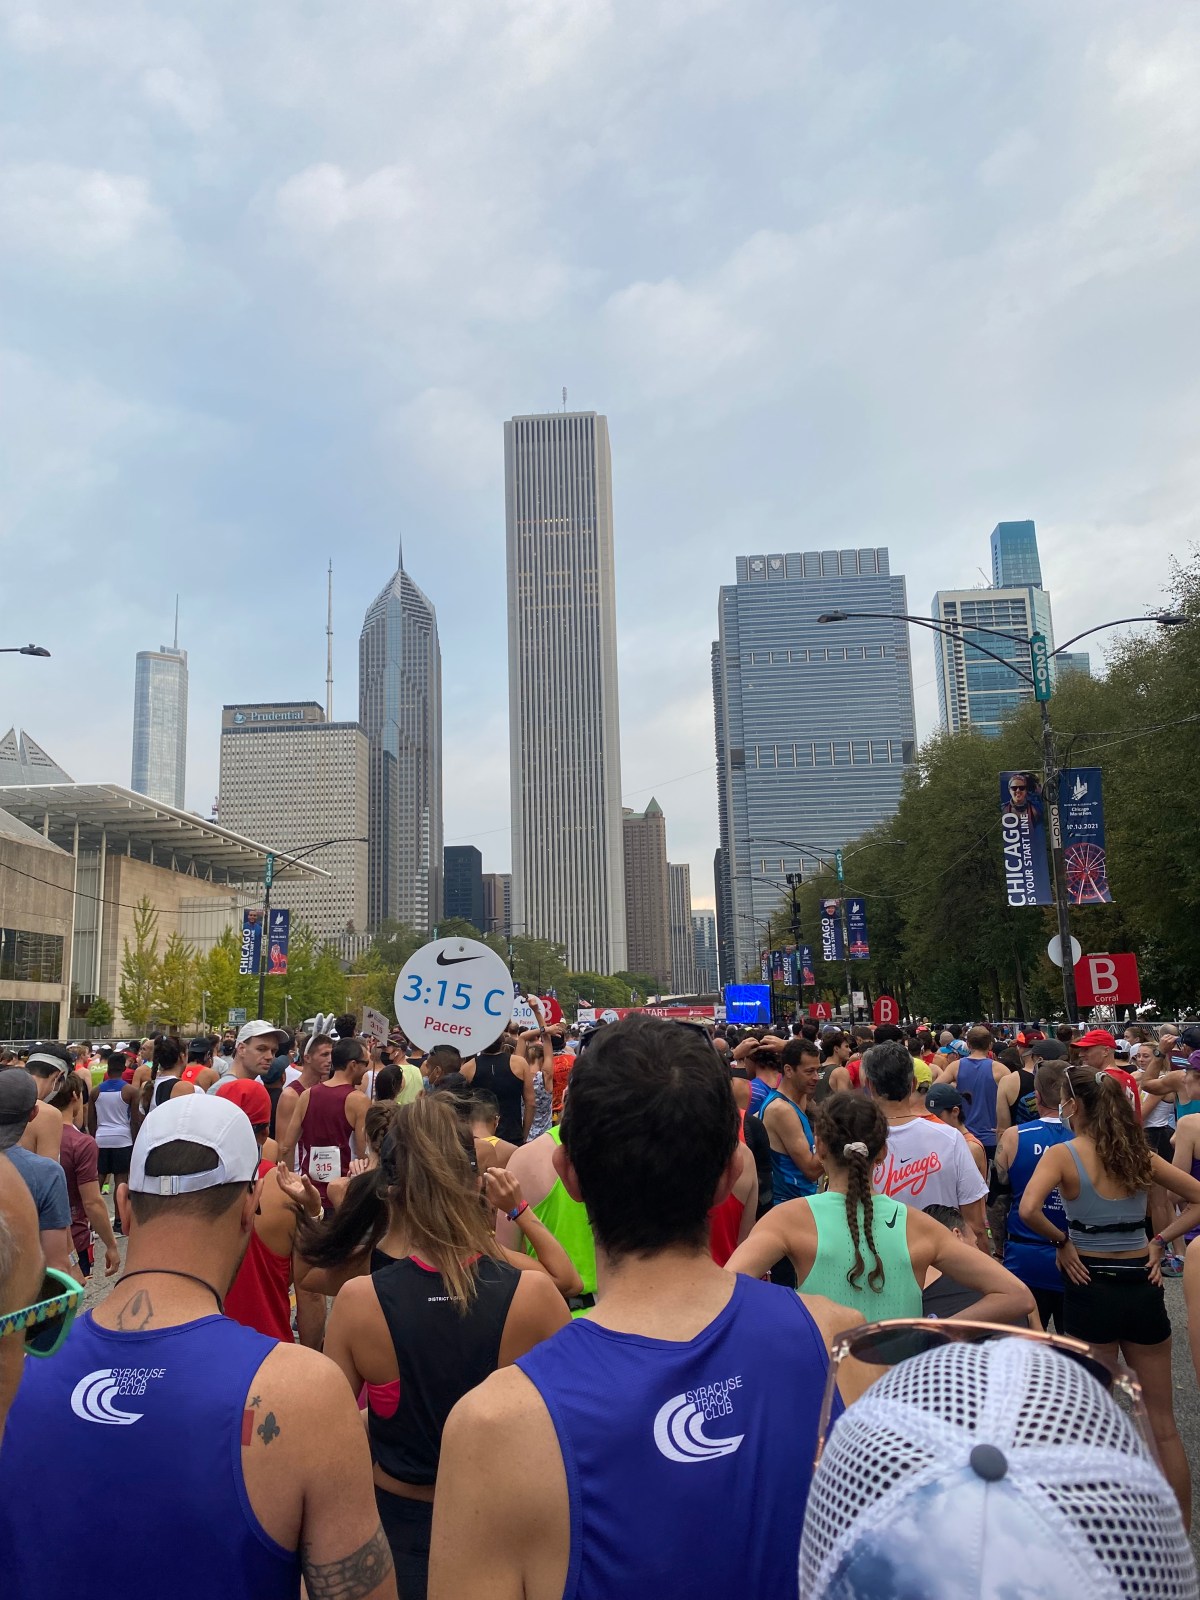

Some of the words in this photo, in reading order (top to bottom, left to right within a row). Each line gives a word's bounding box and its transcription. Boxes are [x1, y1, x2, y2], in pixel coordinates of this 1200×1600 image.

[1033, 641, 1048, 693] C201
[251, 710, 304, 721] Prudential
[1020, 813, 1030, 835] LINE
[1002, 812, 1026, 906] CHICAGO
[1022, 838, 1033, 867] START
[1024, 869, 1036, 895] YOUR
[1028, 897, 1037, 905] IS
[821, 918, 832, 961] CHICAGO
[239, 929, 251, 975] CHICAGO
[1089, 958, 1119, 994] B
[402, 974, 473, 1010] 3:15
[484, 989, 505, 1016] C
[1094, 994, 1119, 1003] Corral
[513, 1008, 532, 1017] 3:10
[816, 1003, 826, 1016] A
[880, 1000, 892, 1021] B
[424, 1016, 472, 1037] Pacers
[315, 1163, 332, 1172] 3:15
[111, 1368, 167, 1379] SYRACUSE
[115, 1377, 148, 1387] TRACK
[118, 1386, 145, 1395] CLUB
[686, 1375, 743, 1403] SYRACUSE
[695, 1391, 731, 1412] TRACK
[704, 1402, 733, 1421] CLUB
